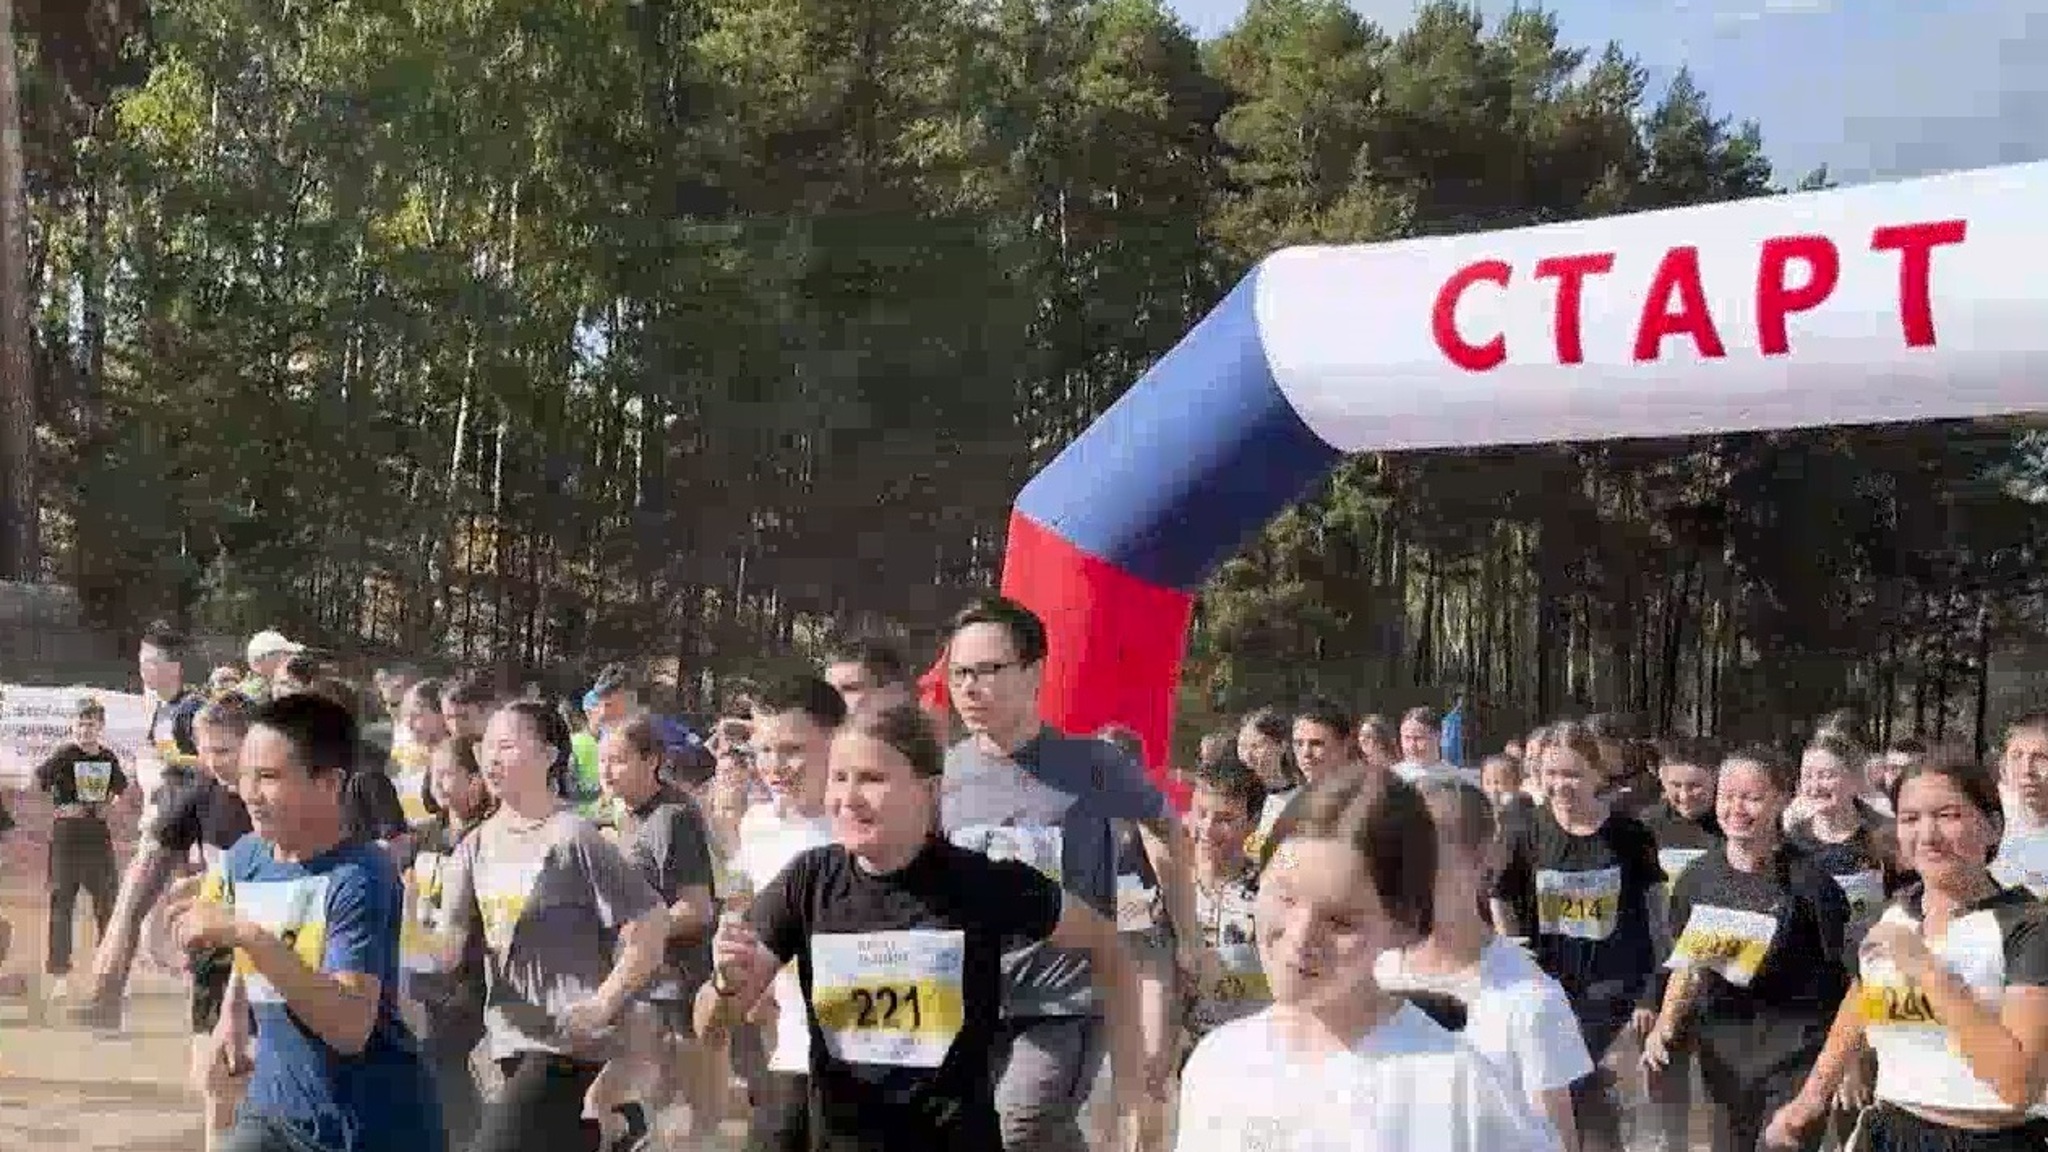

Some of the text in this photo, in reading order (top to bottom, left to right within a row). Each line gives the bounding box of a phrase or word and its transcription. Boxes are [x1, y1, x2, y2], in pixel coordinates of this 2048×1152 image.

[1432, 219, 1967, 373] СТАРТ
[1560, 897, 1602, 919] 214
[851, 986, 921, 1030] 221
